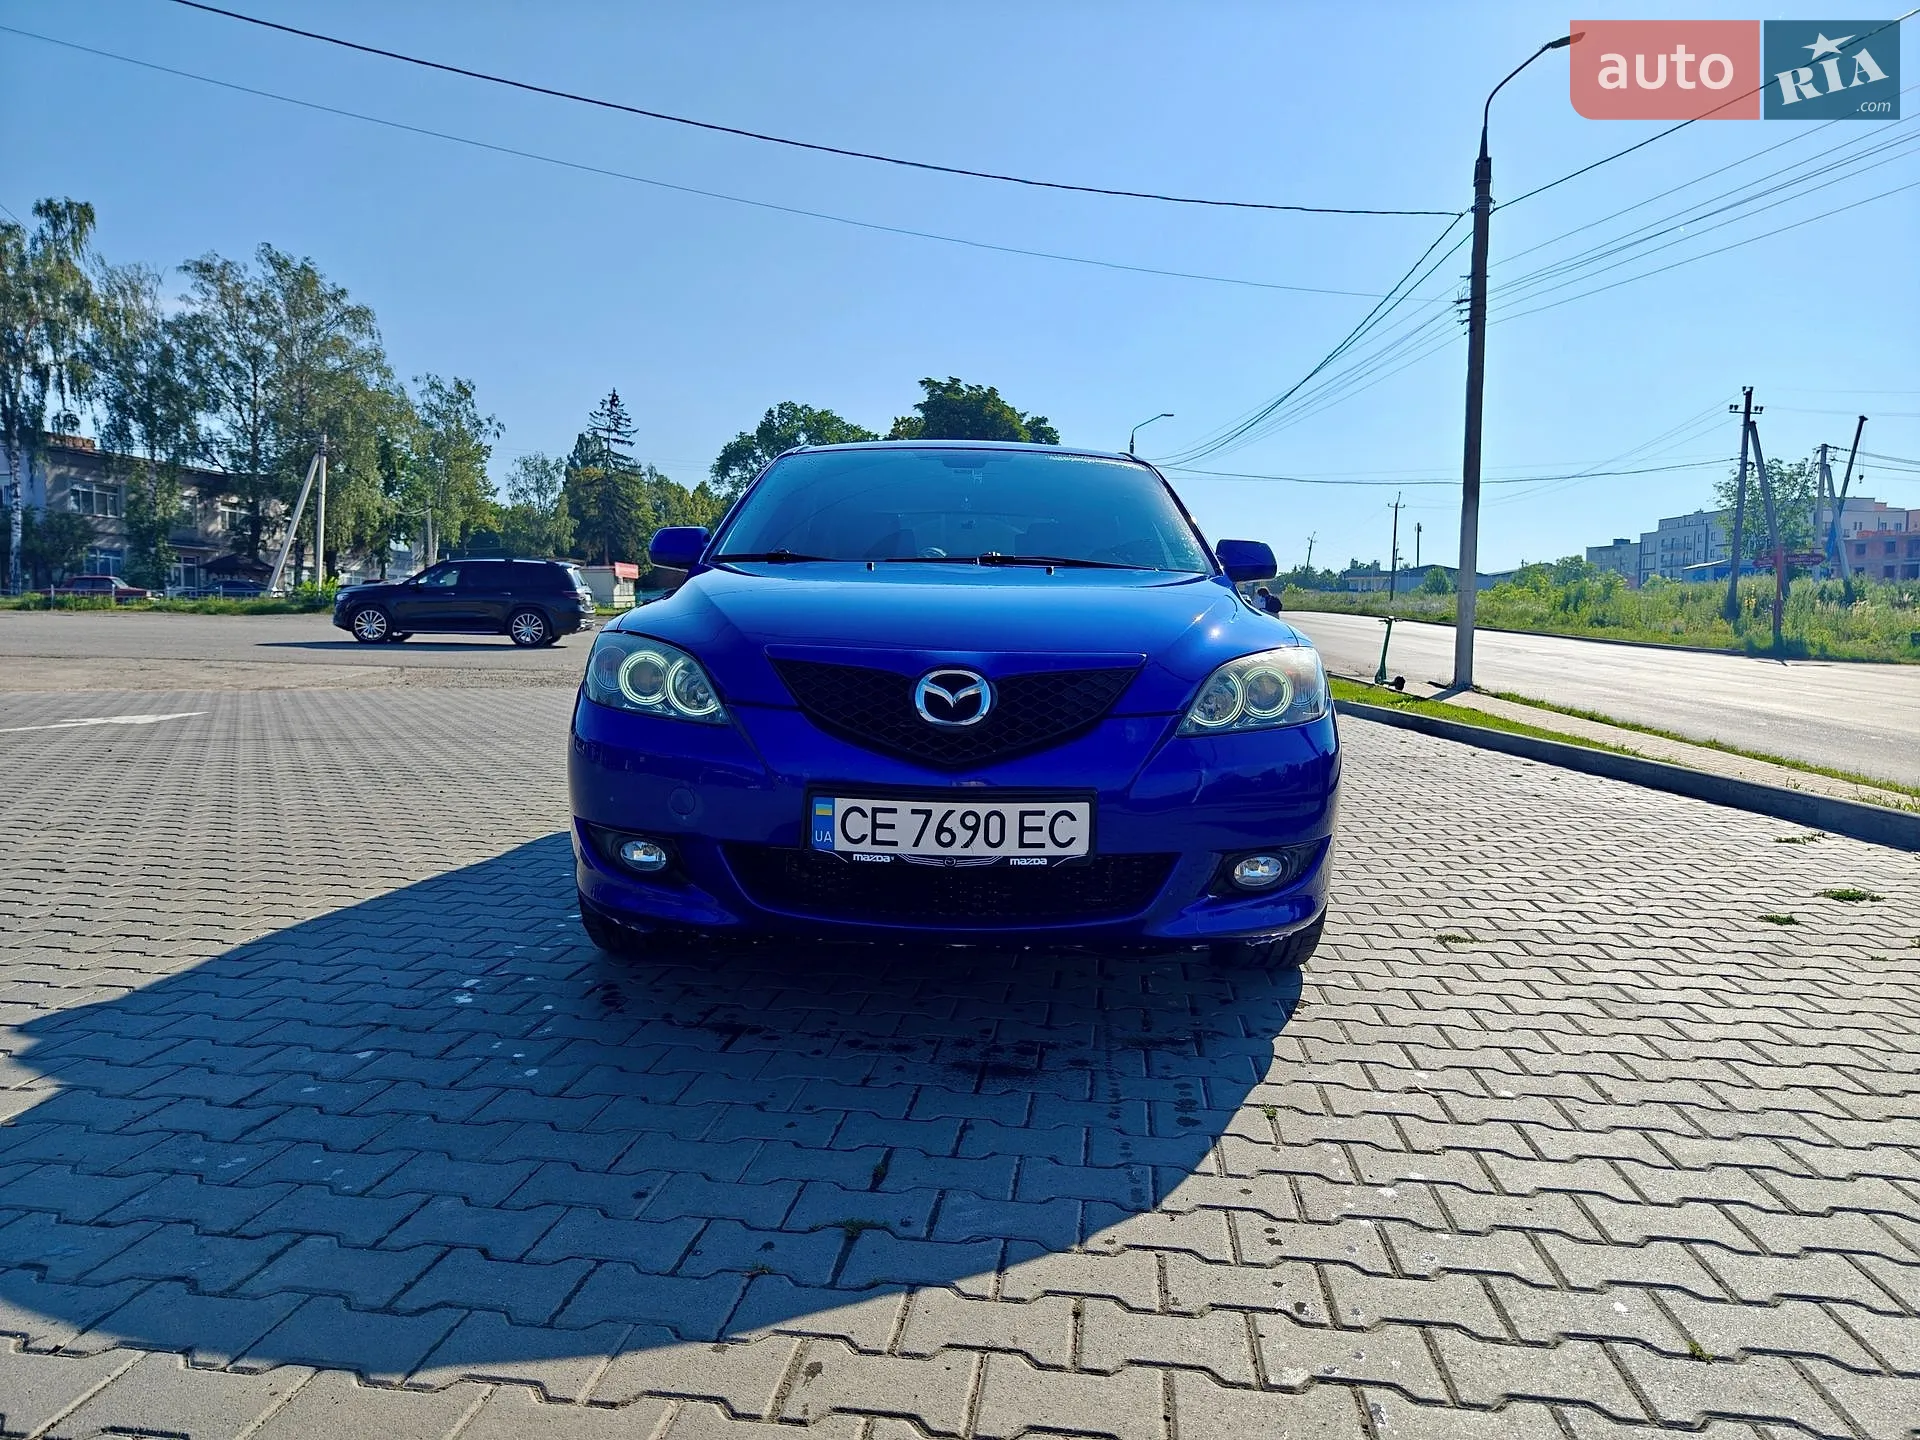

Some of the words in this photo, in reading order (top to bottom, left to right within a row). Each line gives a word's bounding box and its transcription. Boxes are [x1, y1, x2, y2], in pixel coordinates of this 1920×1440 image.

[840, 805, 899, 847] CE
[910, 808, 1006, 849] 7690
[1017, 809, 1078, 849] EC
[815, 830, 833, 843] UA
[852, 853, 891, 863] mazda
[1009, 857, 1048, 866] mazda
